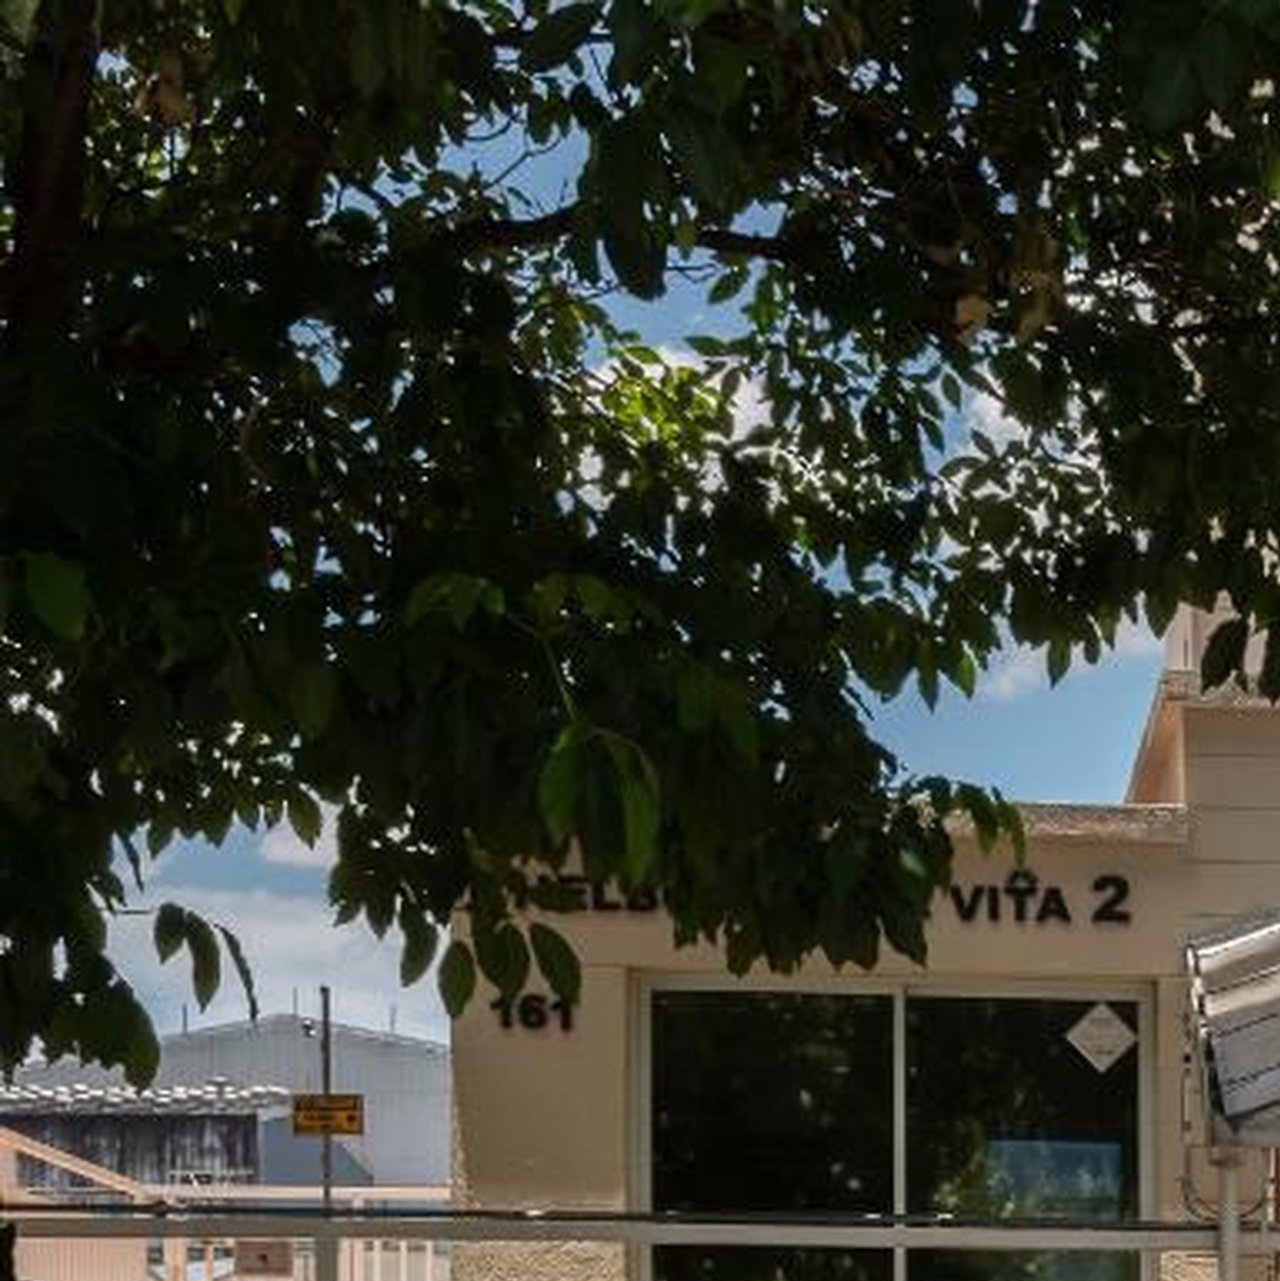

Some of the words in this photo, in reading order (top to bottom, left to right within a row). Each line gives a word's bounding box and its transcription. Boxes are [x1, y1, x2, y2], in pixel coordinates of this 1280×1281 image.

[950, 883, 1071, 922] VITA
[1091, 875, 1131, 922] 2
[490, 993, 572, 1032] 161
